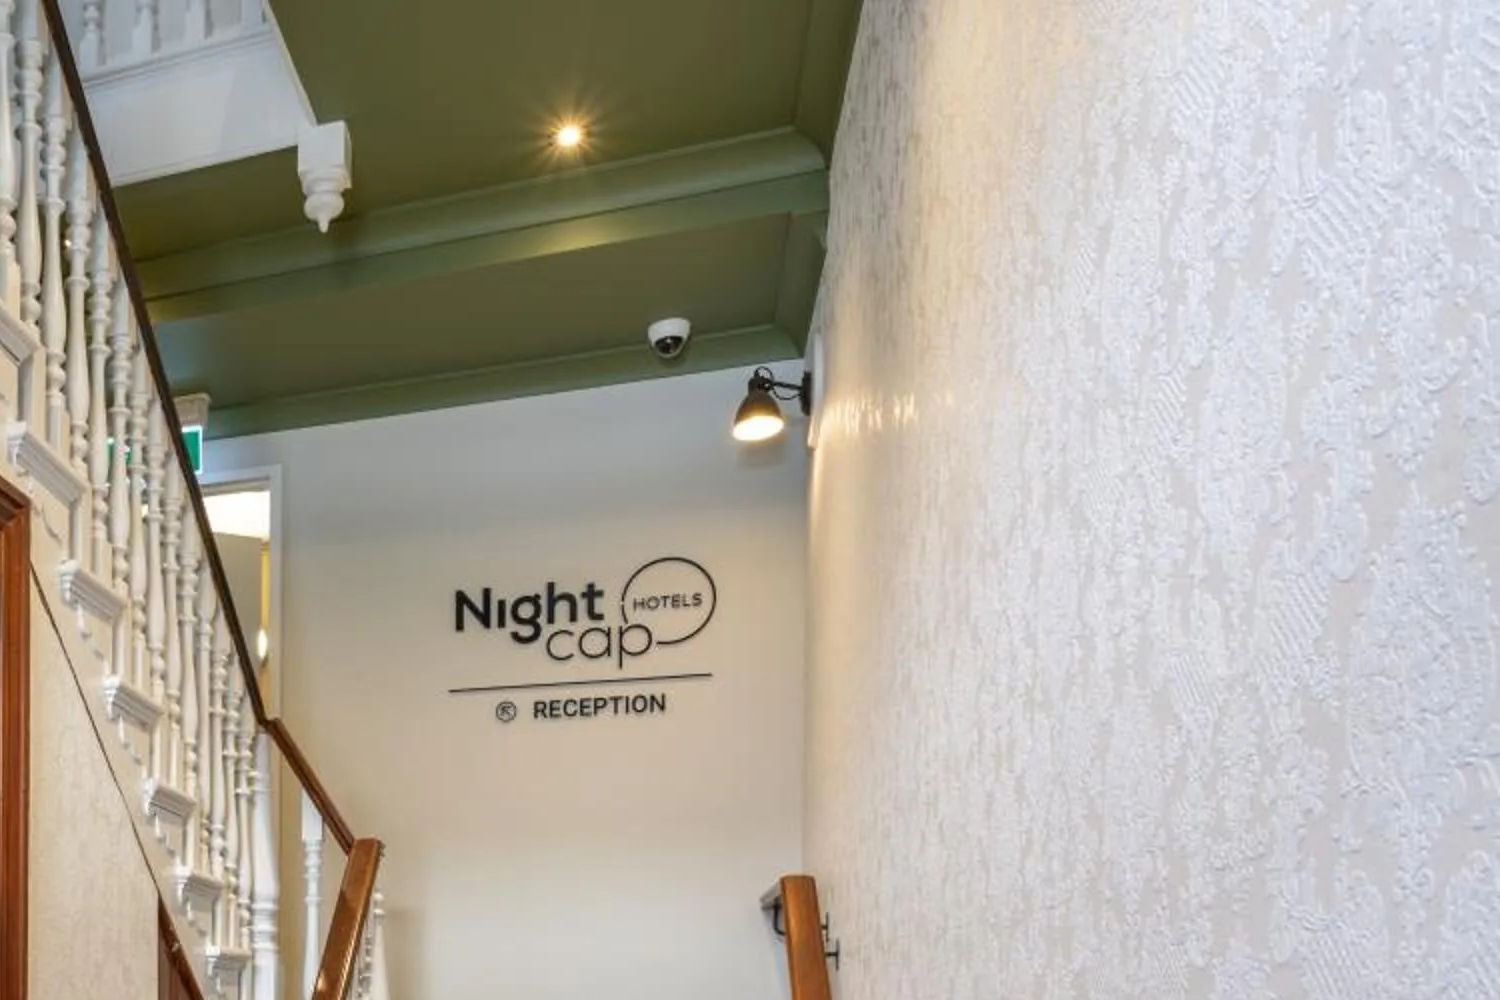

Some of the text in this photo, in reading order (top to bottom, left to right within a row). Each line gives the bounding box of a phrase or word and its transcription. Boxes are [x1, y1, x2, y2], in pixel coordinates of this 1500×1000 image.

[454, 581, 605, 644] Night
[632, 592, 703, 611] HOTELS
[546, 622, 653, 669] cap
[533, 693, 667, 719] RECEPTION
